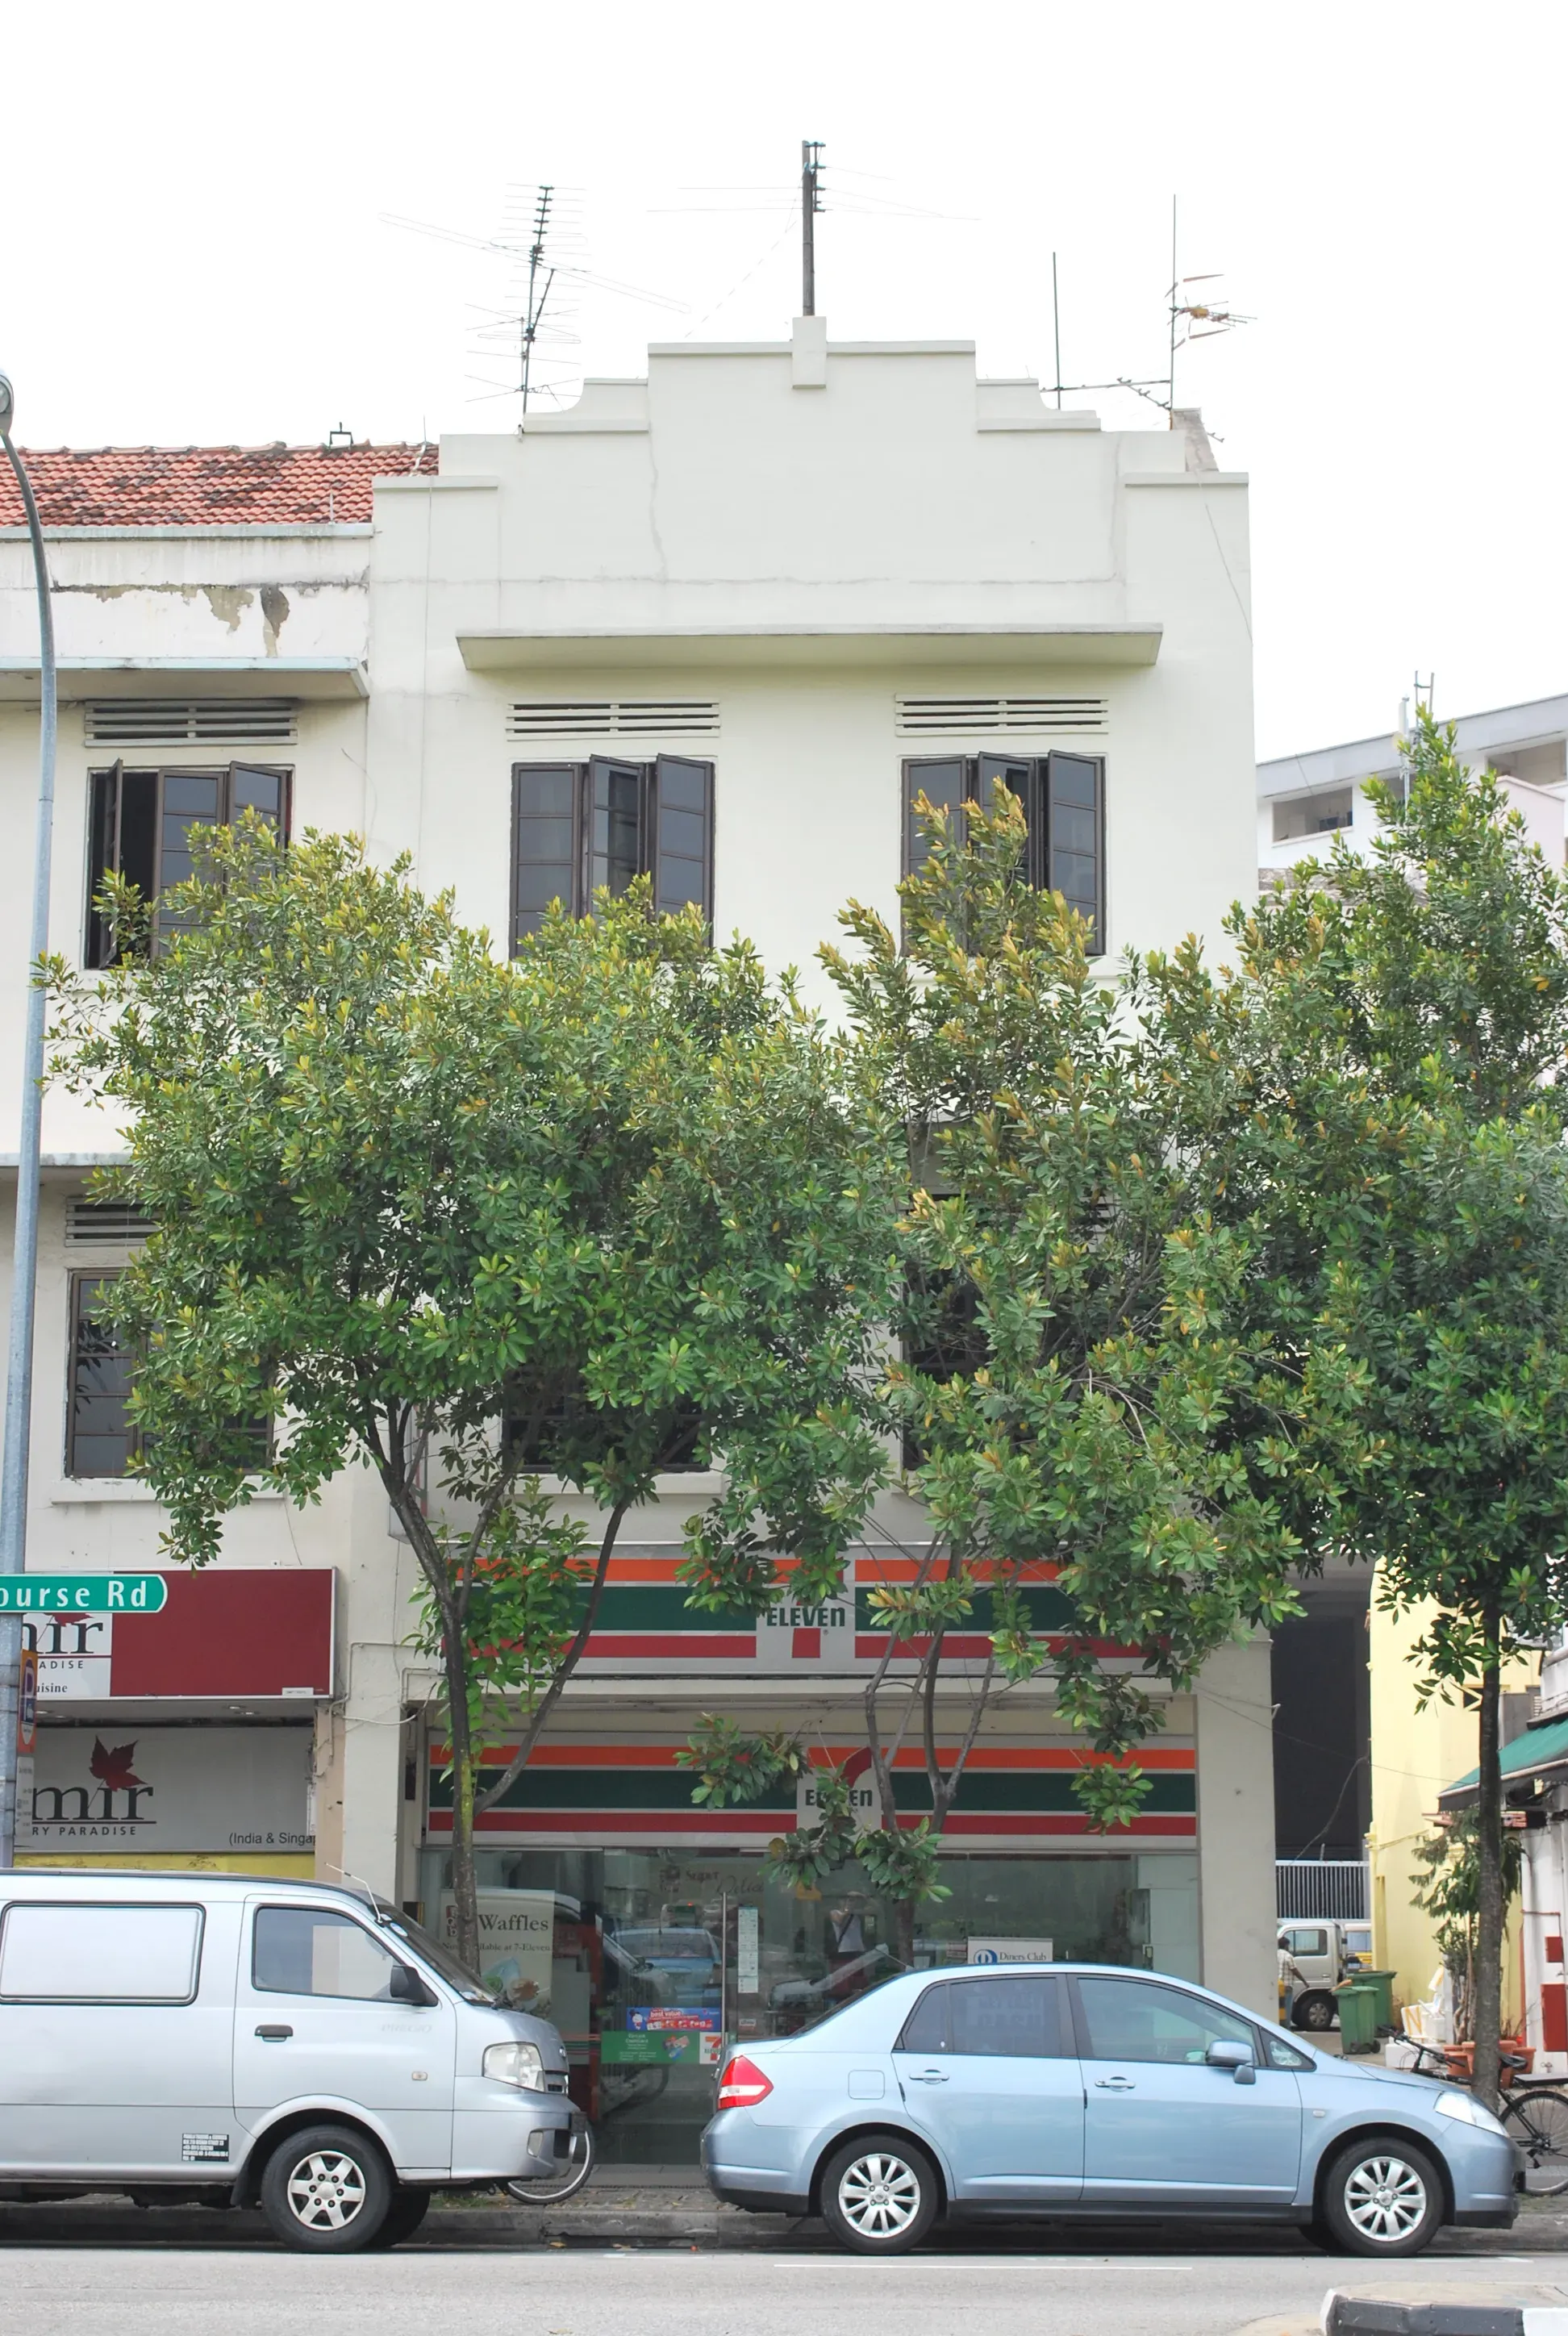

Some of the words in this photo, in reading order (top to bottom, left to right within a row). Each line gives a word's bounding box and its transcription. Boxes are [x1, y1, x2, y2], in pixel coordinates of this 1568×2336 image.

[108, 1580, 146, 1607] Rd
[59, 1826, 136, 1835] PARADISE
[229, 1832, 262, 1846] (India
[265, 1832, 274, 1844] &
[478, 1914, 548, 1931] Waffles
[999, 1951, 1025, 1961] Diners
[1027, 1951, 1047, 1962] Club
